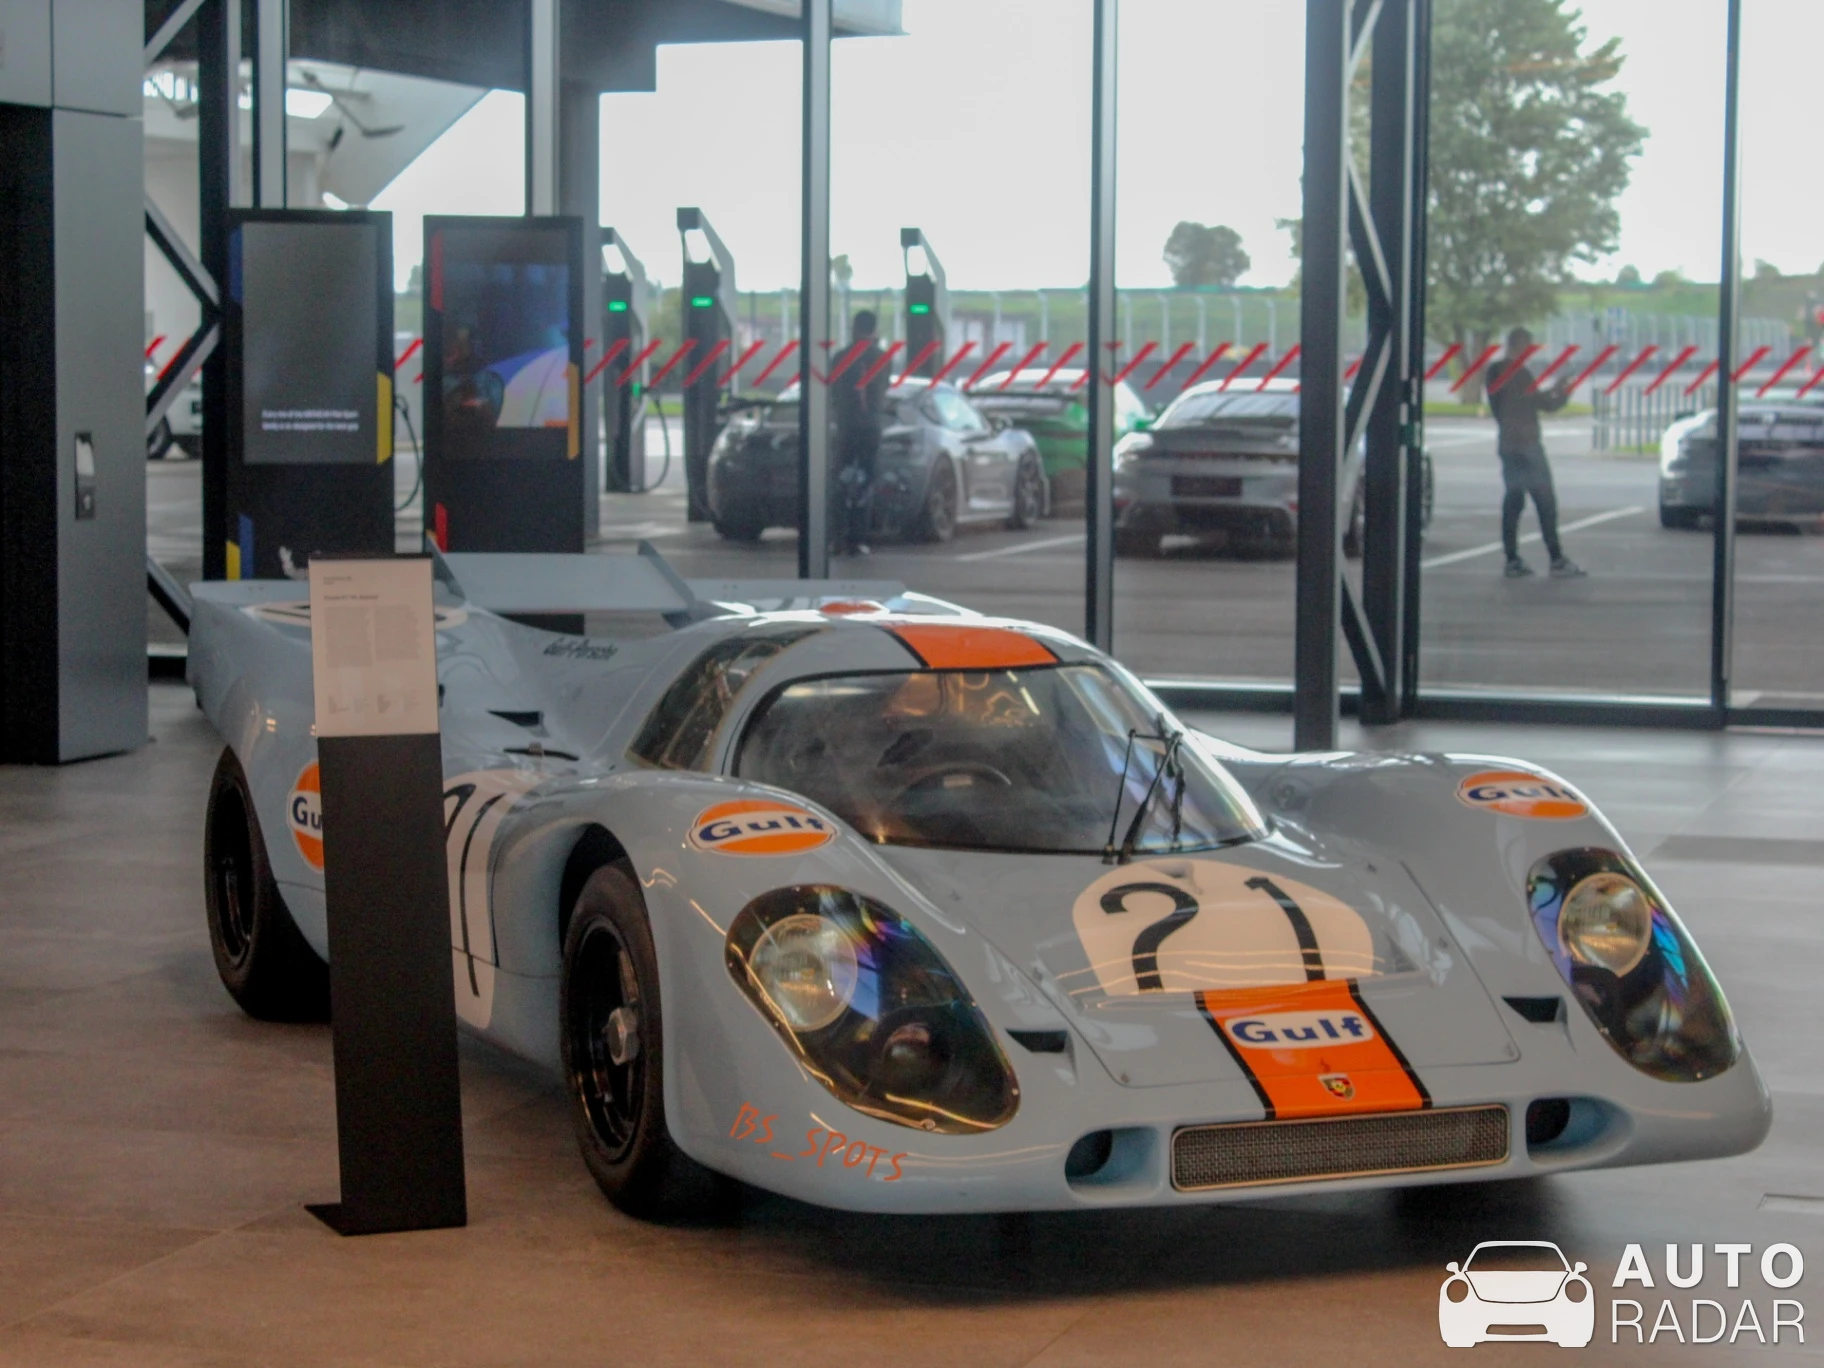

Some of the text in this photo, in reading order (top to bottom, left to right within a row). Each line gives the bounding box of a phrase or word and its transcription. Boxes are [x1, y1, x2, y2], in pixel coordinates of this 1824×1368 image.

[292, 796, 322, 830] Gu
[698, 815, 824, 842] Gulf
[1099, 876, 1327, 994] 21
[1231, 1015, 1365, 1043] Gulf
